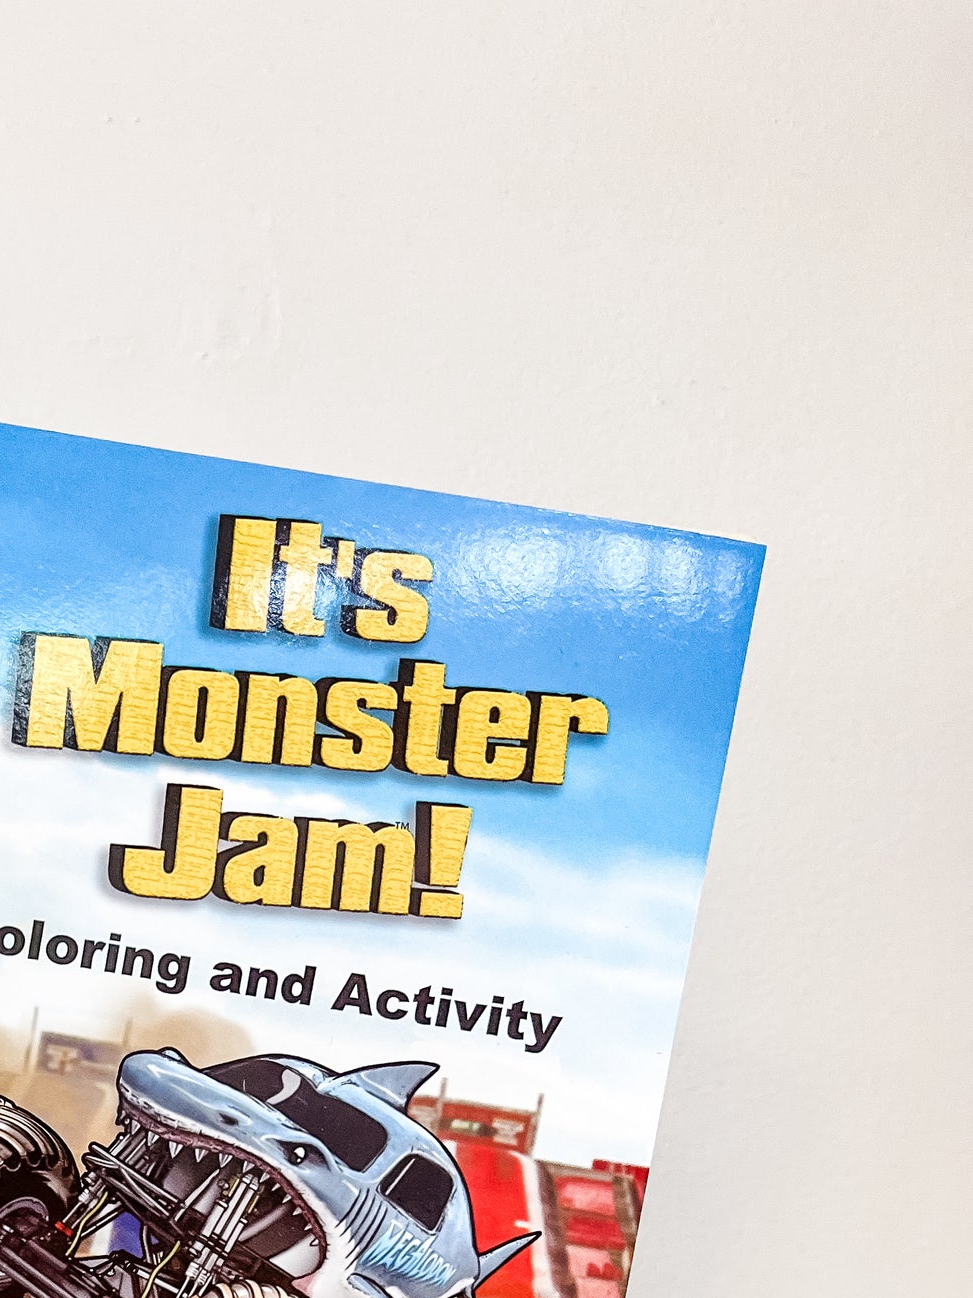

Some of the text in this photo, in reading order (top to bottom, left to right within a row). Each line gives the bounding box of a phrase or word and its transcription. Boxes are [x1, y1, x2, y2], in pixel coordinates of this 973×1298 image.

[217, 515, 434, 643] It's
[17, 632, 609, 786] Monster
[110, 784, 473, 919] Jam!
[210, 959, 316, 1005] and
[331, 973, 563, 1054] Activity
[360, 1219, 457, 1287] MEGALODON
